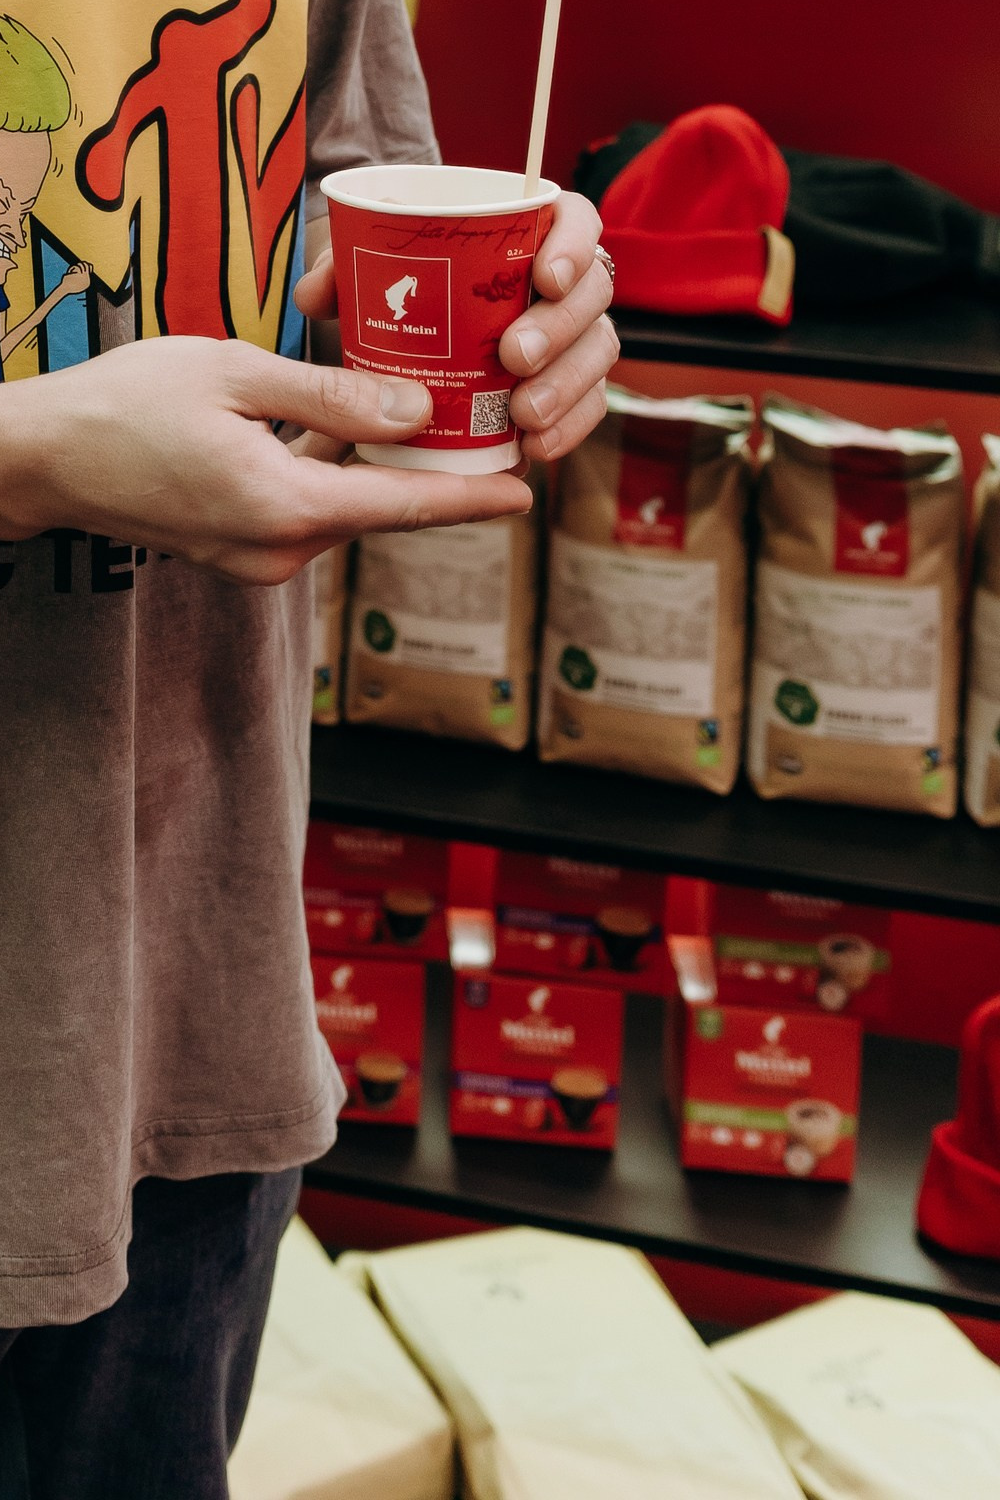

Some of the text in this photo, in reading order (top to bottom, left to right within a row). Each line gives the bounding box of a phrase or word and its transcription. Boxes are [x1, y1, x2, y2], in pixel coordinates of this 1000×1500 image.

[365, 317, 438, 336] Julius Meinl
[370, 361, 401, 373] венской
[401, 367, 445, 379] кофейной
[445, 370, 487, 381] культуры.
[426, 379, 445, 387] 1862
[445, 379, 467, 388] года.
